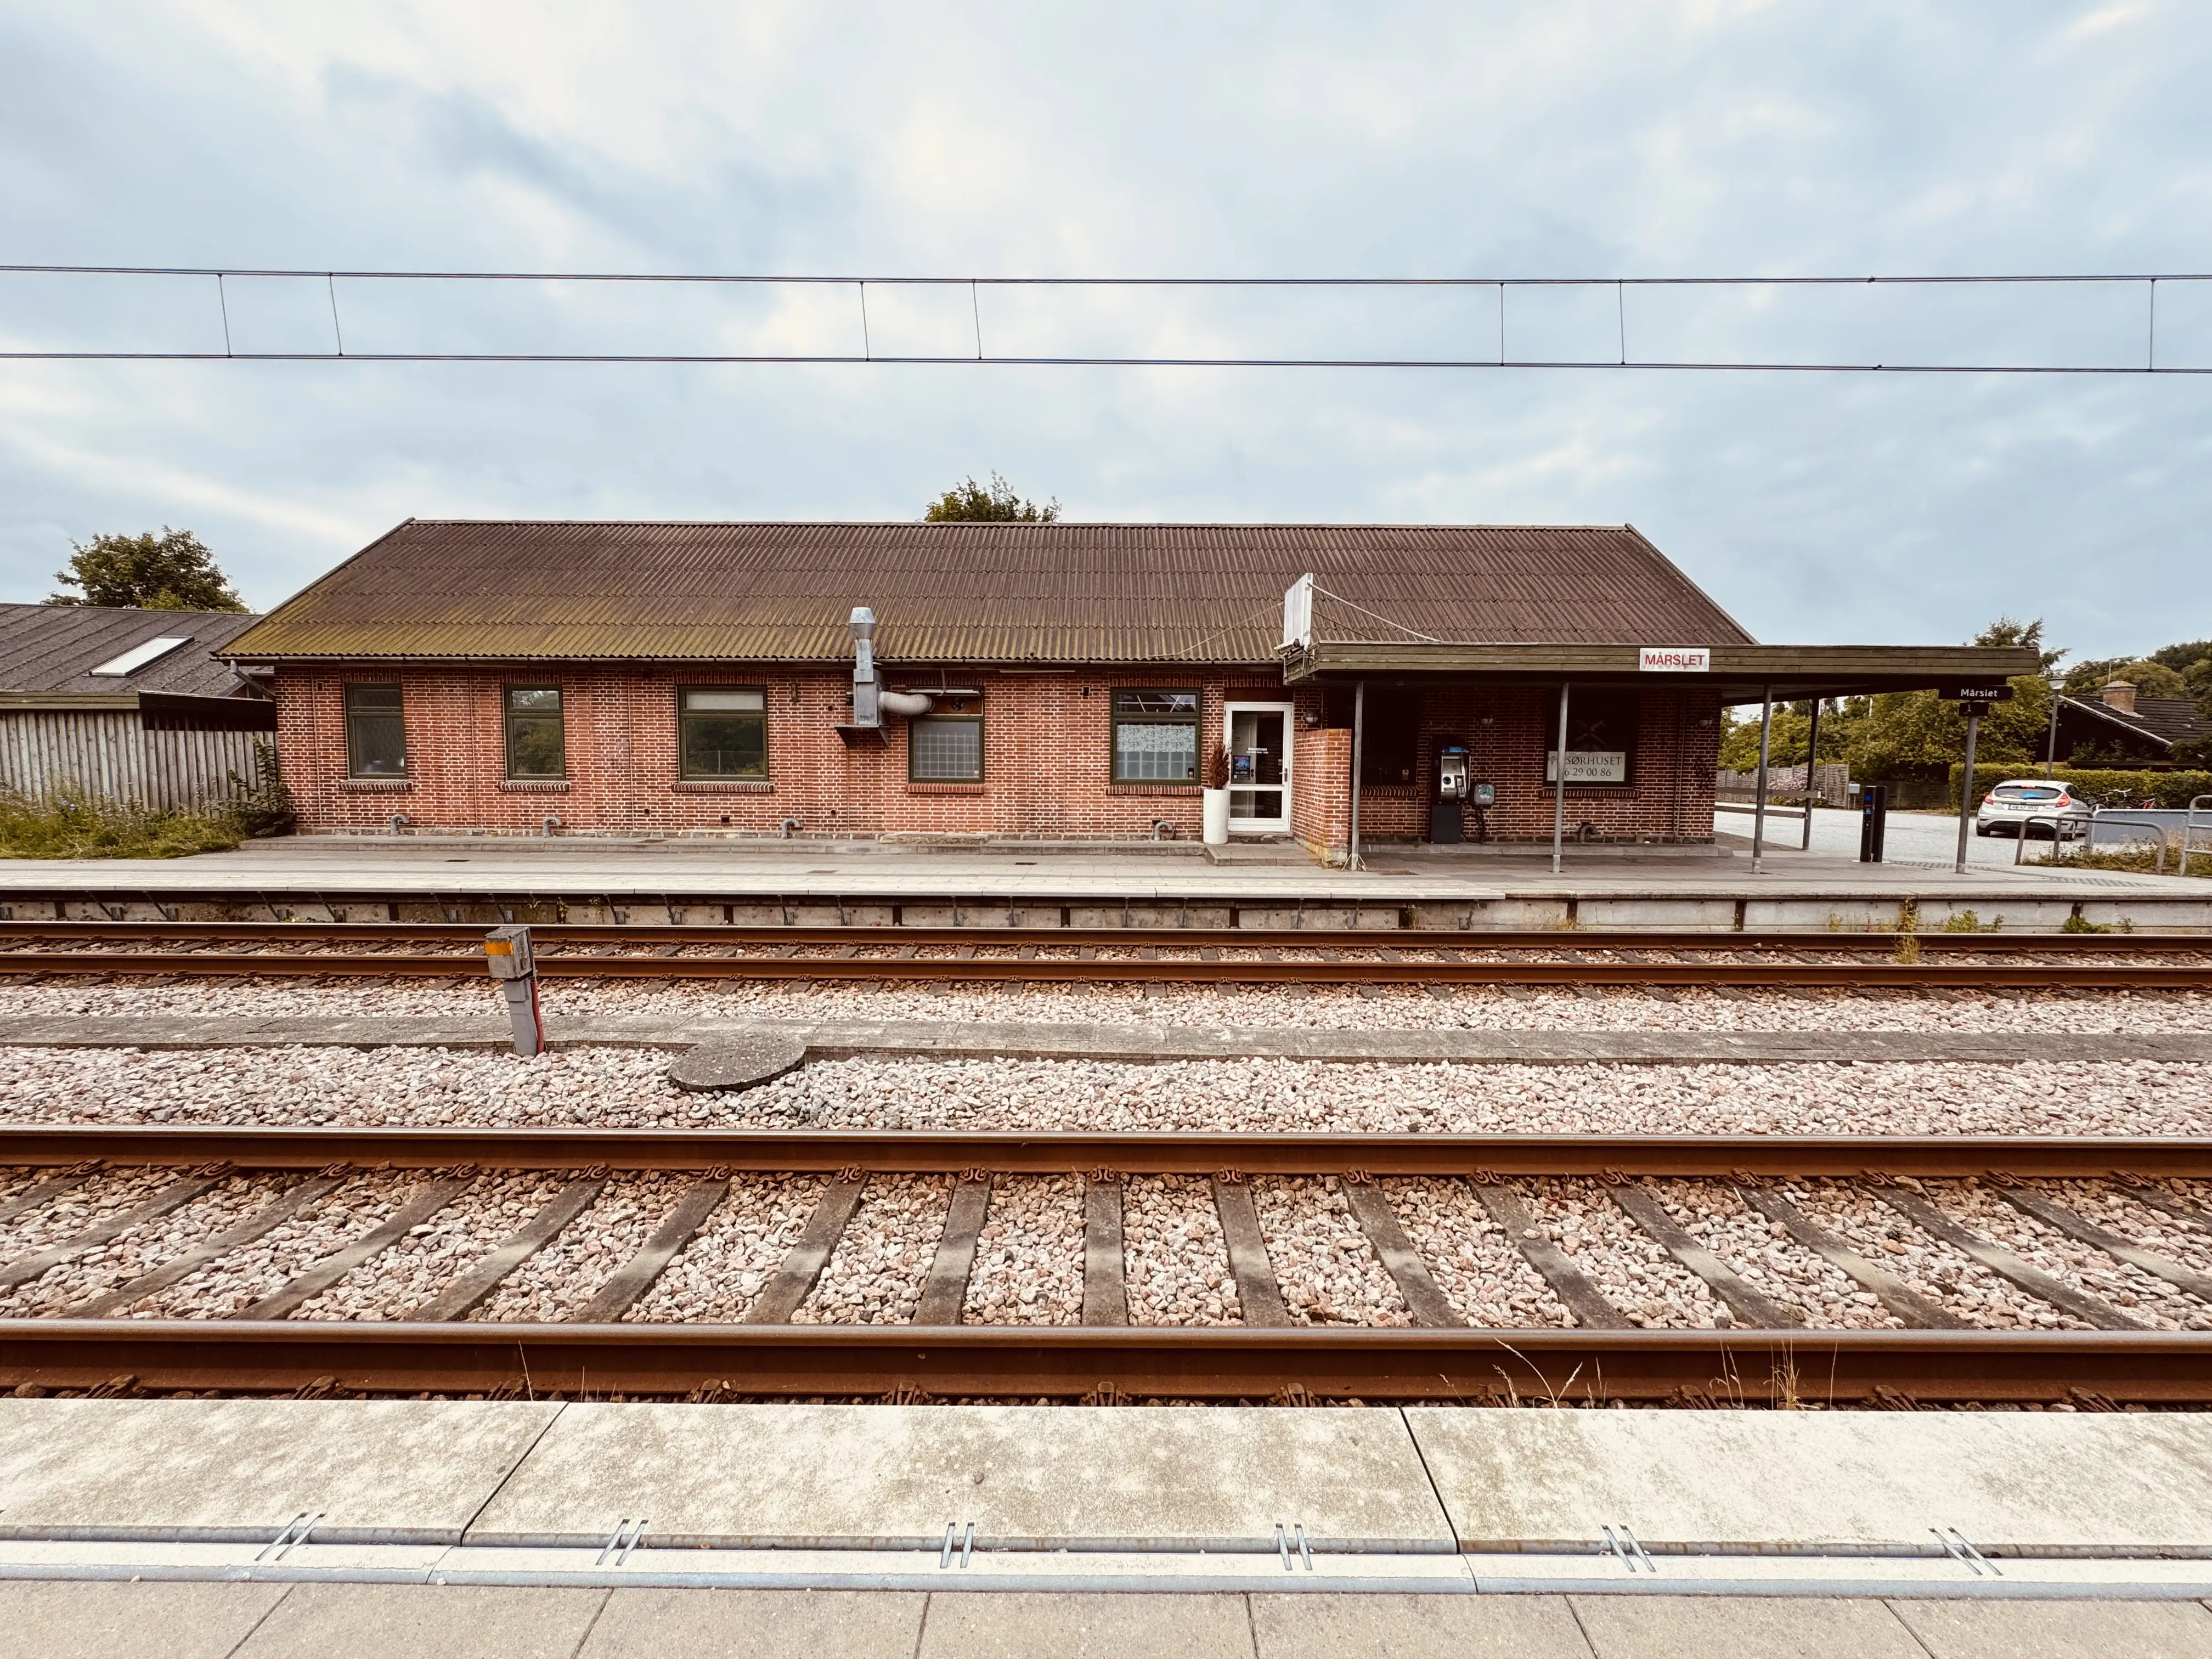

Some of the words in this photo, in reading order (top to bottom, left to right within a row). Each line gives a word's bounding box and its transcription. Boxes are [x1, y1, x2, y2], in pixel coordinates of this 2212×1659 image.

[1645, 651, 1705, 665] MÅRSLET
[1960, 689, 1997, 697] Mårslet
[1549, 756, 1622, 765] FSØRHUSET
[1573, 768, 1583, 776] 29
[1586, 768, 1598, 776] 00
[1600, 768, 1611, 776] 86
